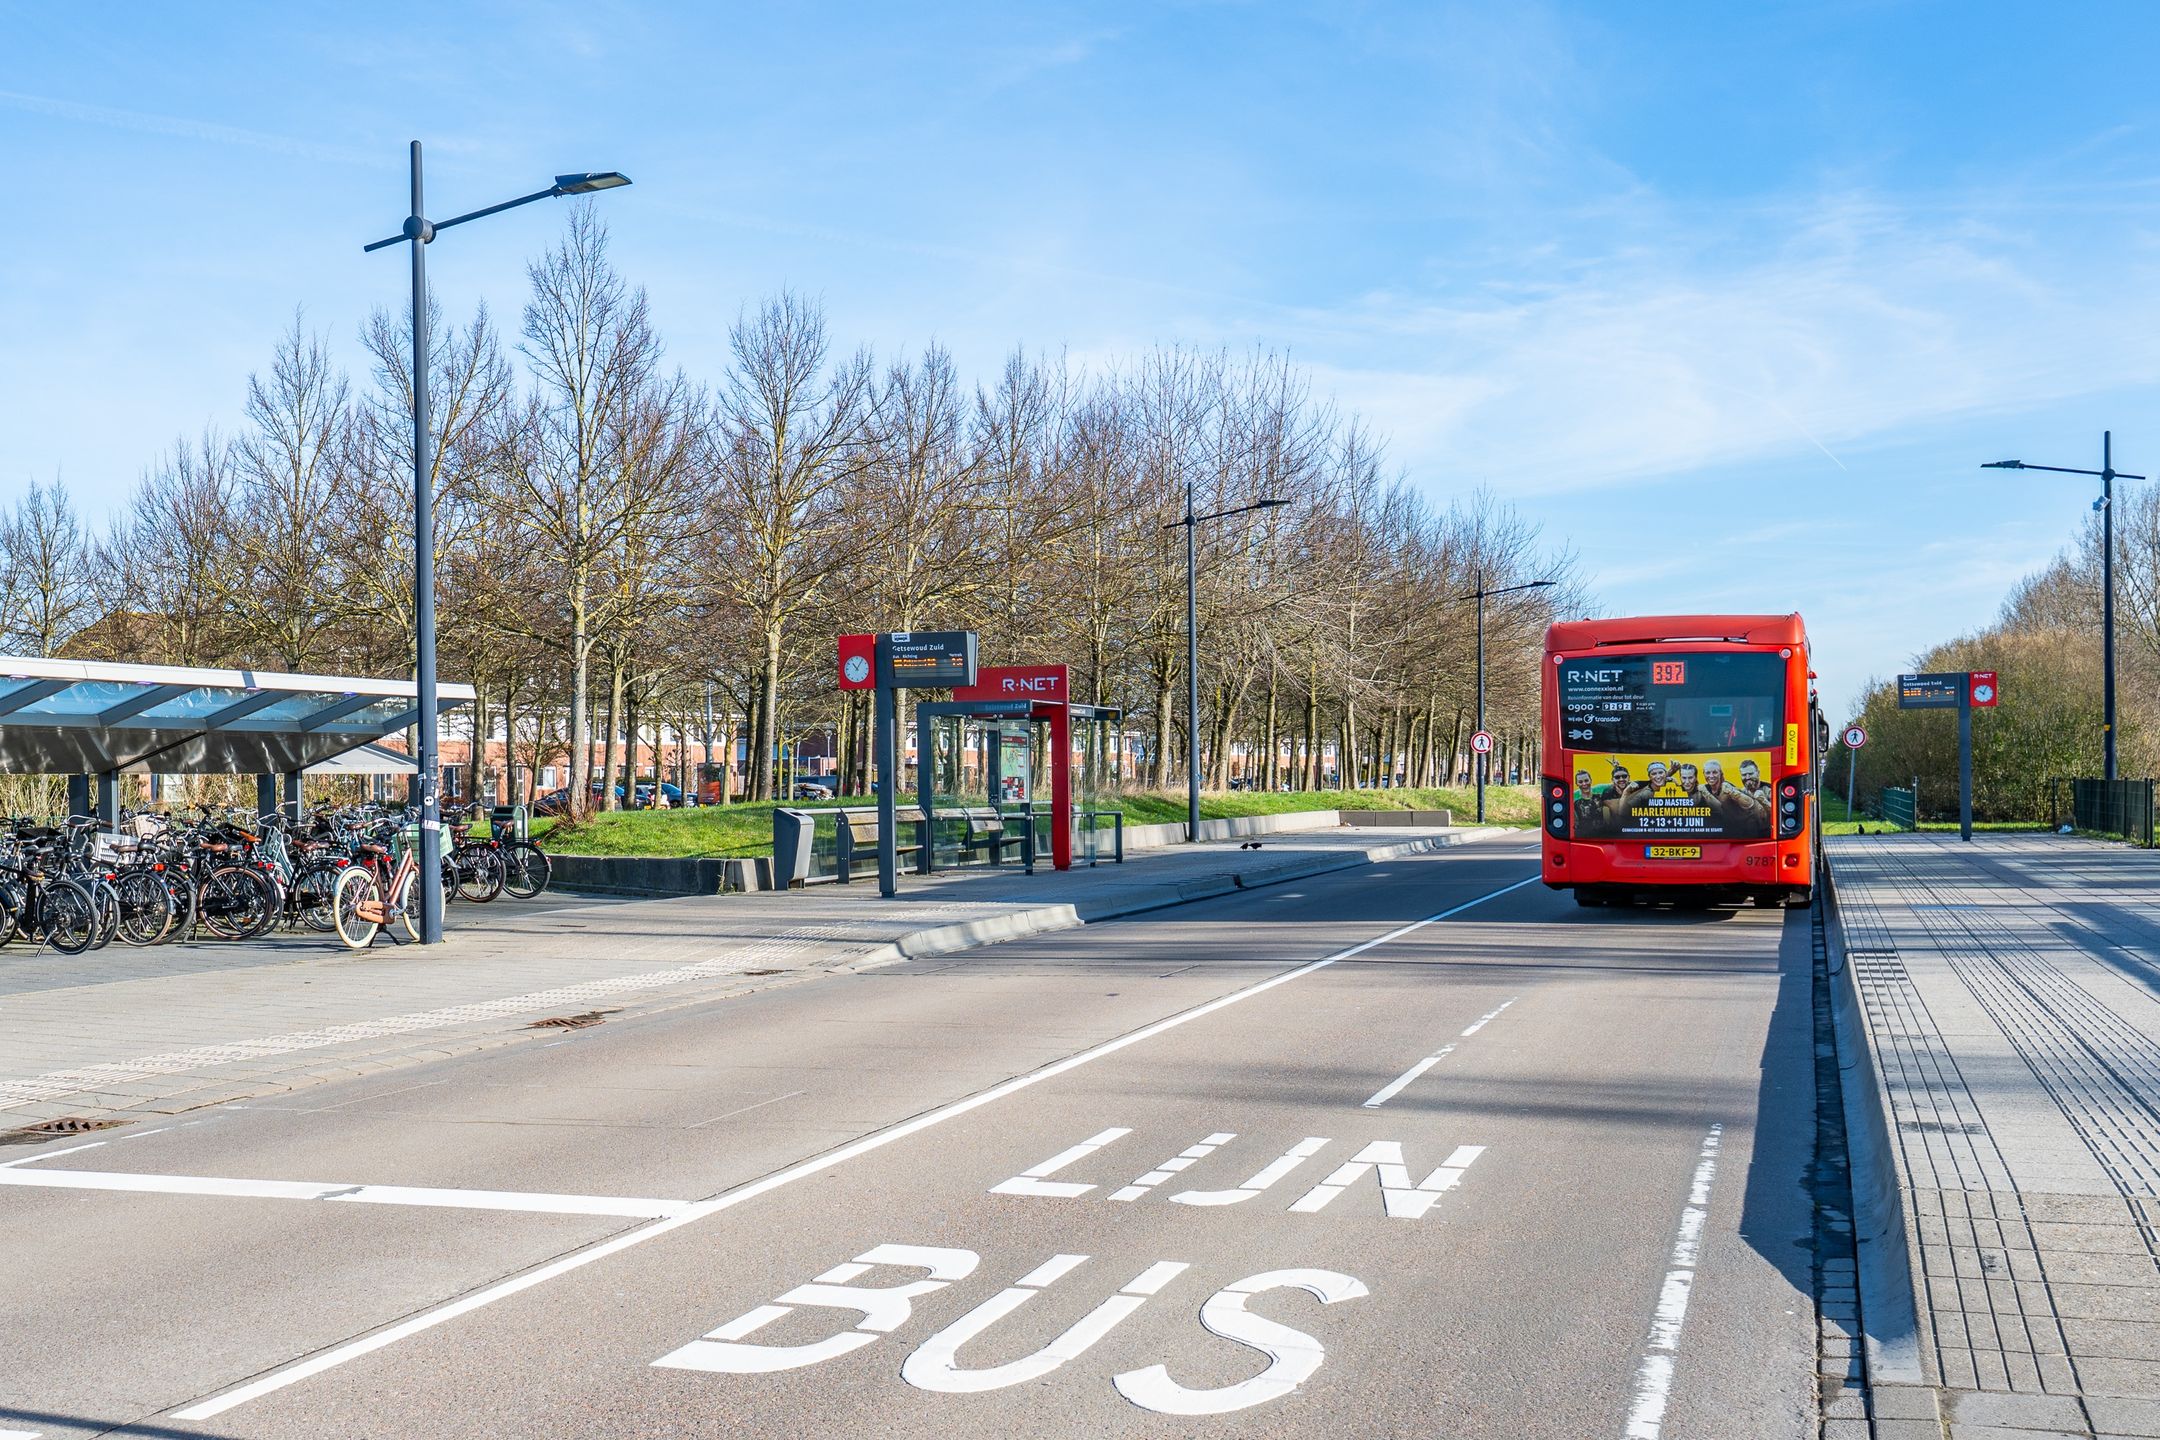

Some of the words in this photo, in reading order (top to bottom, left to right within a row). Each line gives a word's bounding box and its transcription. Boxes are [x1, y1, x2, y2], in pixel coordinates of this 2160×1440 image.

[1655, 665, 1682, 681] 397
[1568, 703, 1594, 712] 0900
[1648, 798, 1664, 806] MUD
[1664, 798, 1694, 806] MASTERS
[1631, 807, 1711, 817] HAARLEMMERMEER
[1685, 817, 1704, 827] JUNI
[1653, 847, 1697, 857] 32-BKF-9
[1746, 856, 1776, 867] 9787
[986, 1127, 1487, 1220] LIJN
[650, 1243, 1370, 1416] BUS
